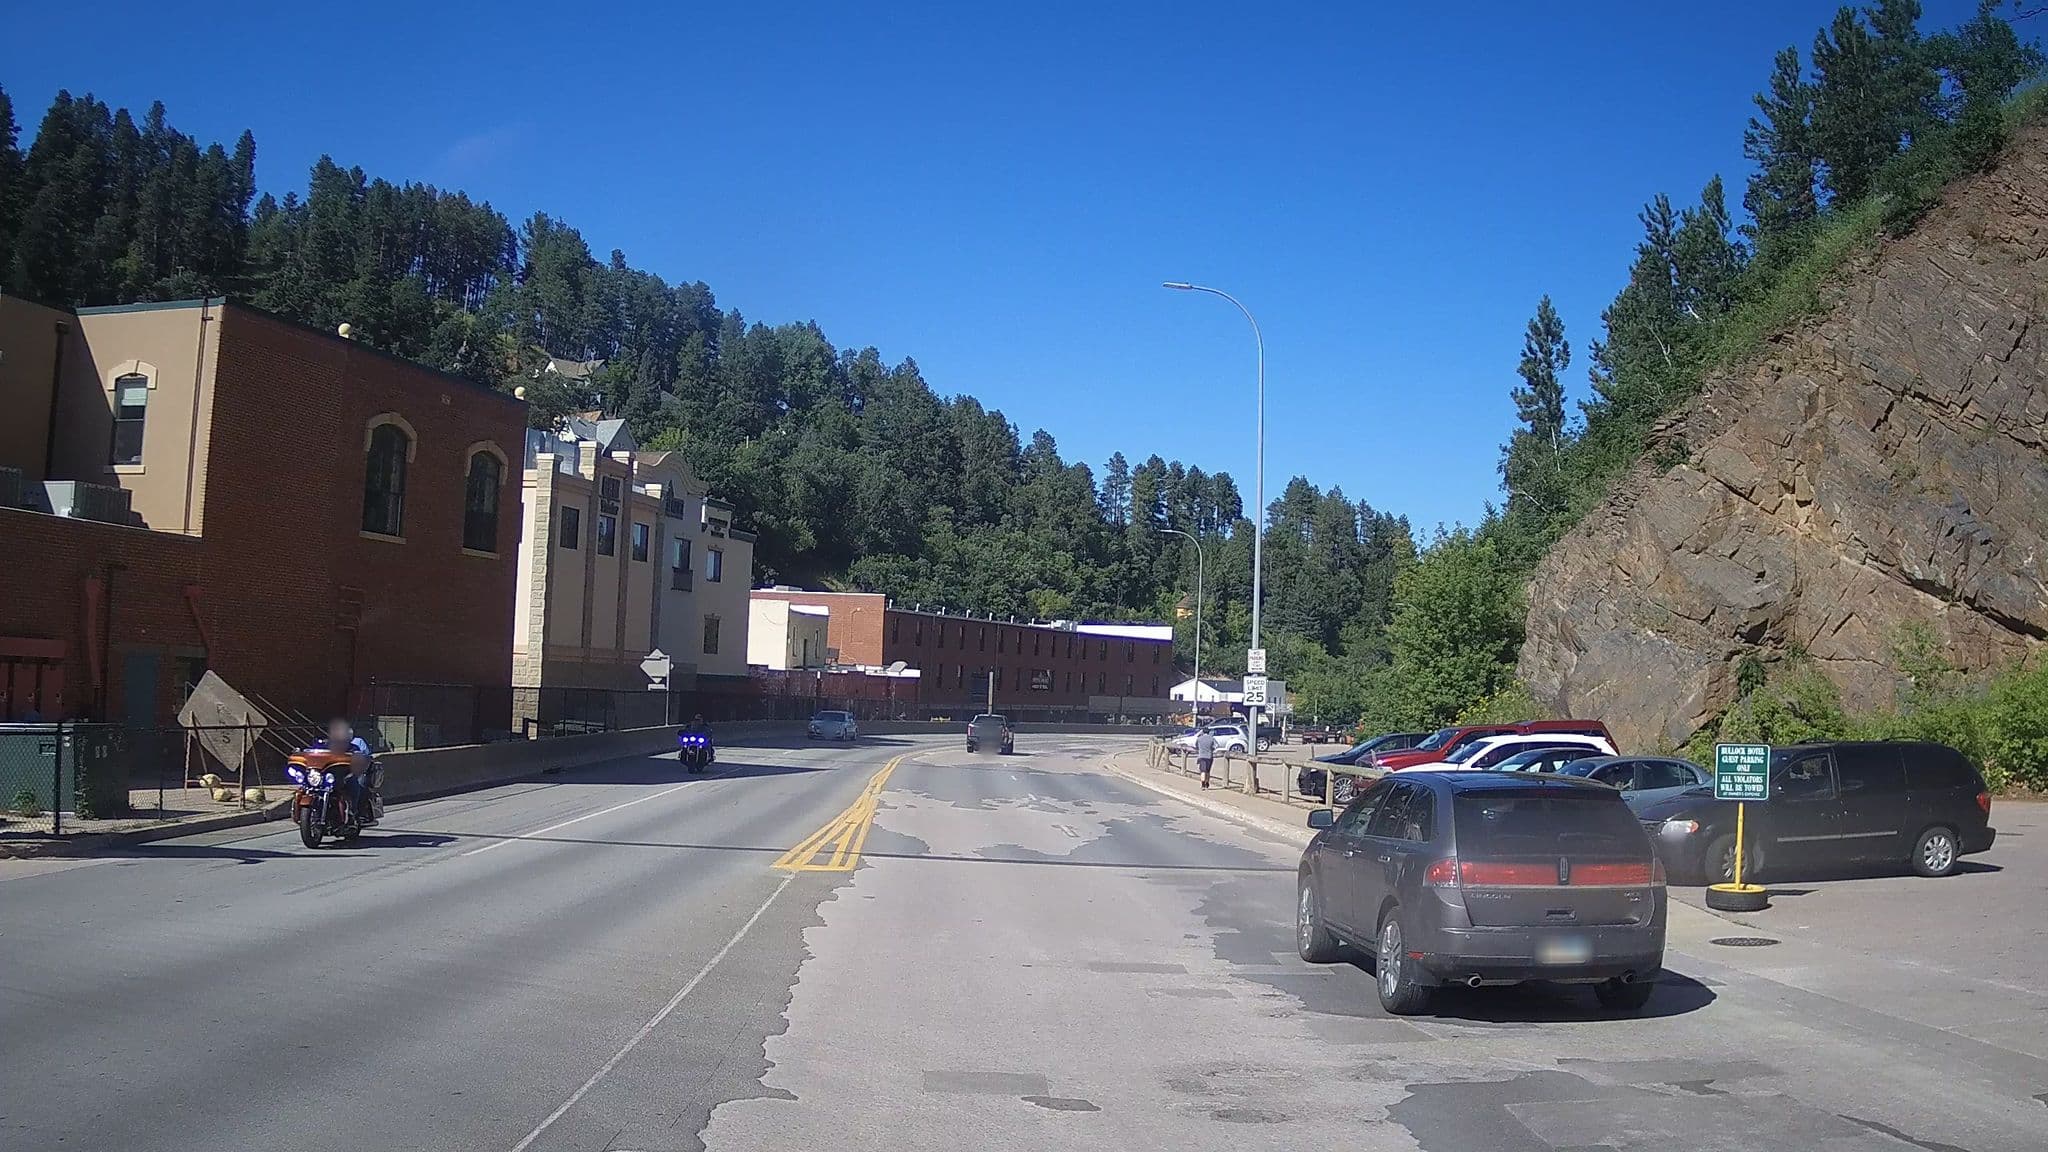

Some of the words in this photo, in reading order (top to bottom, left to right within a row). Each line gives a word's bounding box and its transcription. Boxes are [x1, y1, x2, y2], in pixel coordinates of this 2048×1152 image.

[1246, 692, 1264, 702] 25
[1721, 747, 1745, 755] BULLOCK
[1740, 756, 1764, 764] PARKING
